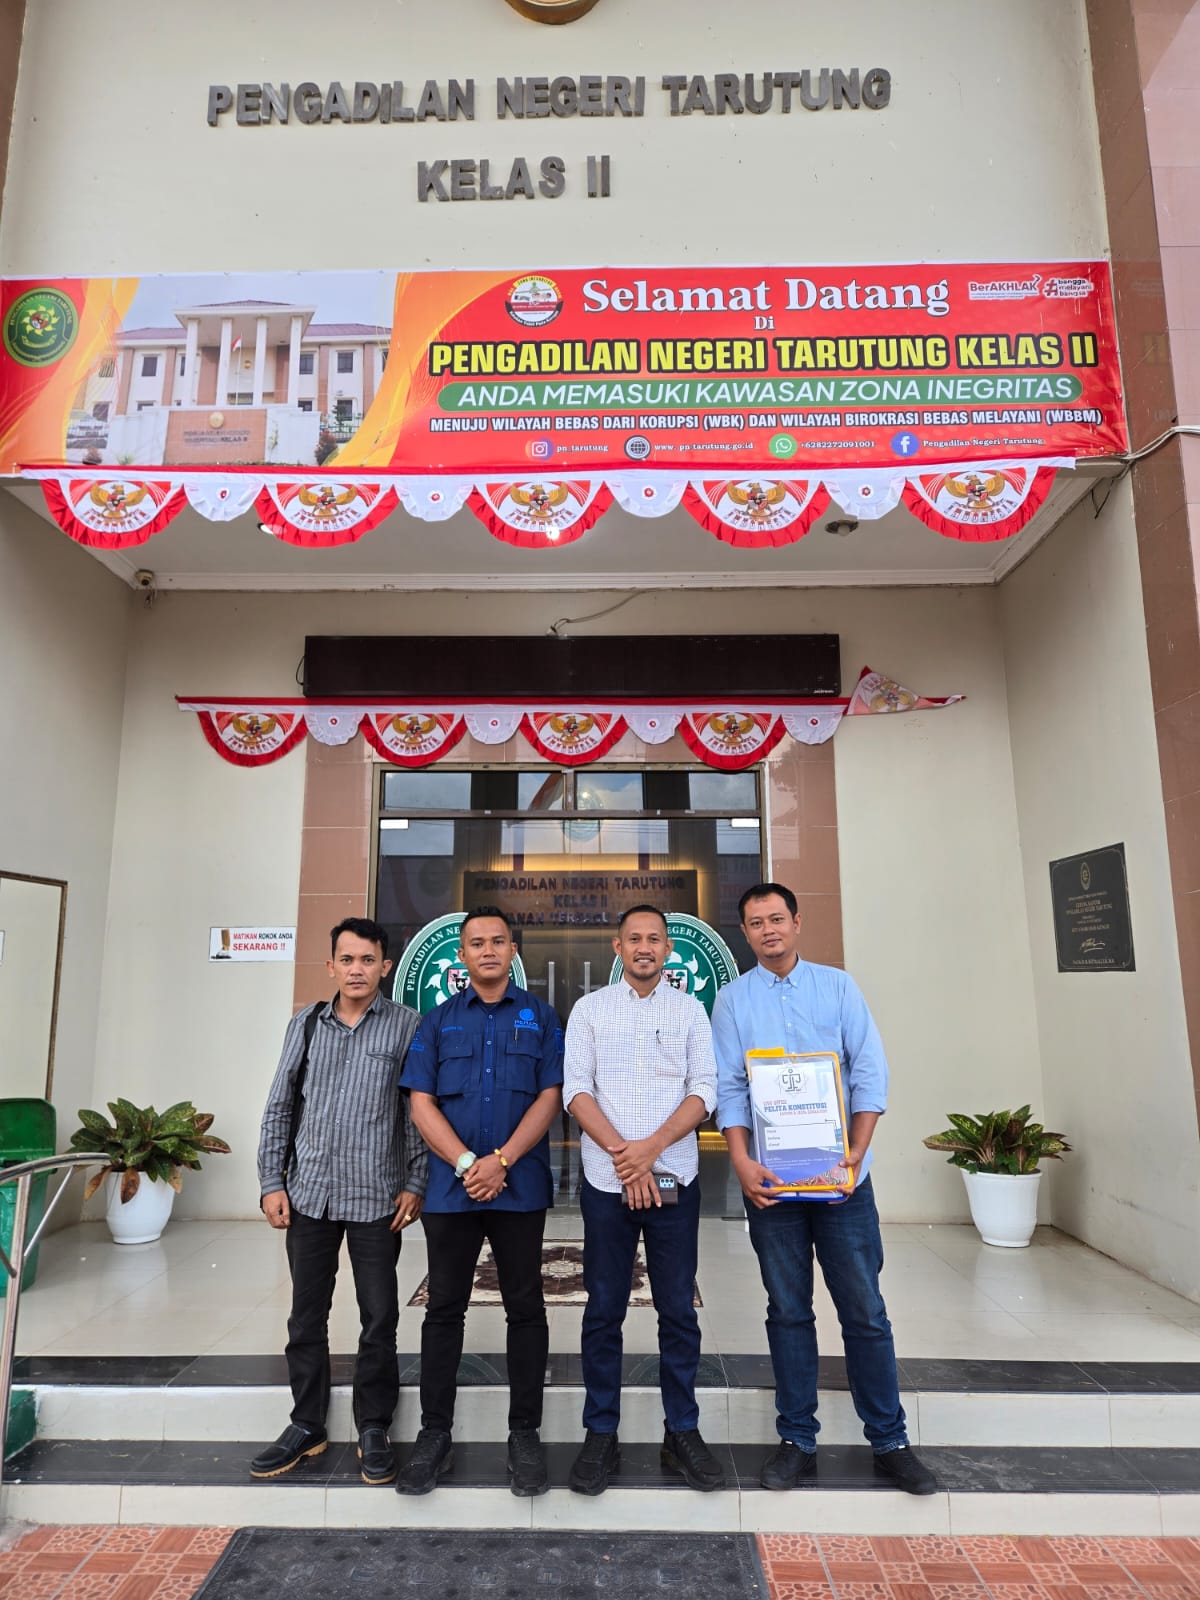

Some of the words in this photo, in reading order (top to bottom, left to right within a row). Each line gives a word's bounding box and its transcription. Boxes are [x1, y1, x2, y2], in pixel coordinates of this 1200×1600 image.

[207, 79, 475, 127] PENGADILAN
[496, 75, 646, 119] NEGERI
[661, 68, 892, 116] TARUTUNG
[417, 156, 566, 202] KELAS
[587, 155, 611, 197] II
[583, 278, 771, 313] Selamat
[784, 277, 950, 316] Datang
[969, 282, 1037, 292] BerAKHLAK
[754, 316, 776, 330] Di
[430, 341, 639, 375] PENGADILAN
[648, 339, 768, 373] NEGERI
[775, 336, 948, 370] TARUTUNG
[957, 334, 1063, 367] KELAS
[1070, 333, 1098, 366] II
[458, 384, 538, 407] ANDA
[543, 382, 691, 406] MEMASUKI
[695, 379, 837, 404] KAWASAN
[840, 378, 921, 402] ZONA
[927, 376, 1074, 400] INEGRITAS
[430, 418, 488, 432] MENUJU
[491, 417, 551, 431] WILAYAH
[555, 416, 599, 430] BEBAS
[603, 416, 636, 429] DARI
[639, 415, 699, 429] KORUPSI
[703, 414, 745, 430] (WBK)
[749, 413, 777, 428] DAN
[780, 412, 841, 427] WILAYAH
[845, 411, 919, 426] BIROKRASI
[923, 411, 969, 425] BEBAS
[972, 410, 1042, 424] MELAYANI
[1045, 408, 1102, 425] (WBBM)
[922, 439, 971, 448] Pengadilan
[973, 438, 1001, 447] Negeri
[233, 932, 257, 940] MATIKAN
[258, 932, 277, 940] ROKOK
[278, 932, 293, 940] ANDA
[667, 926, 697, 938] EGERI
[232, 943, 278, 951] SEKARANG
[406, 931, 445, 991] PENGADILAN
